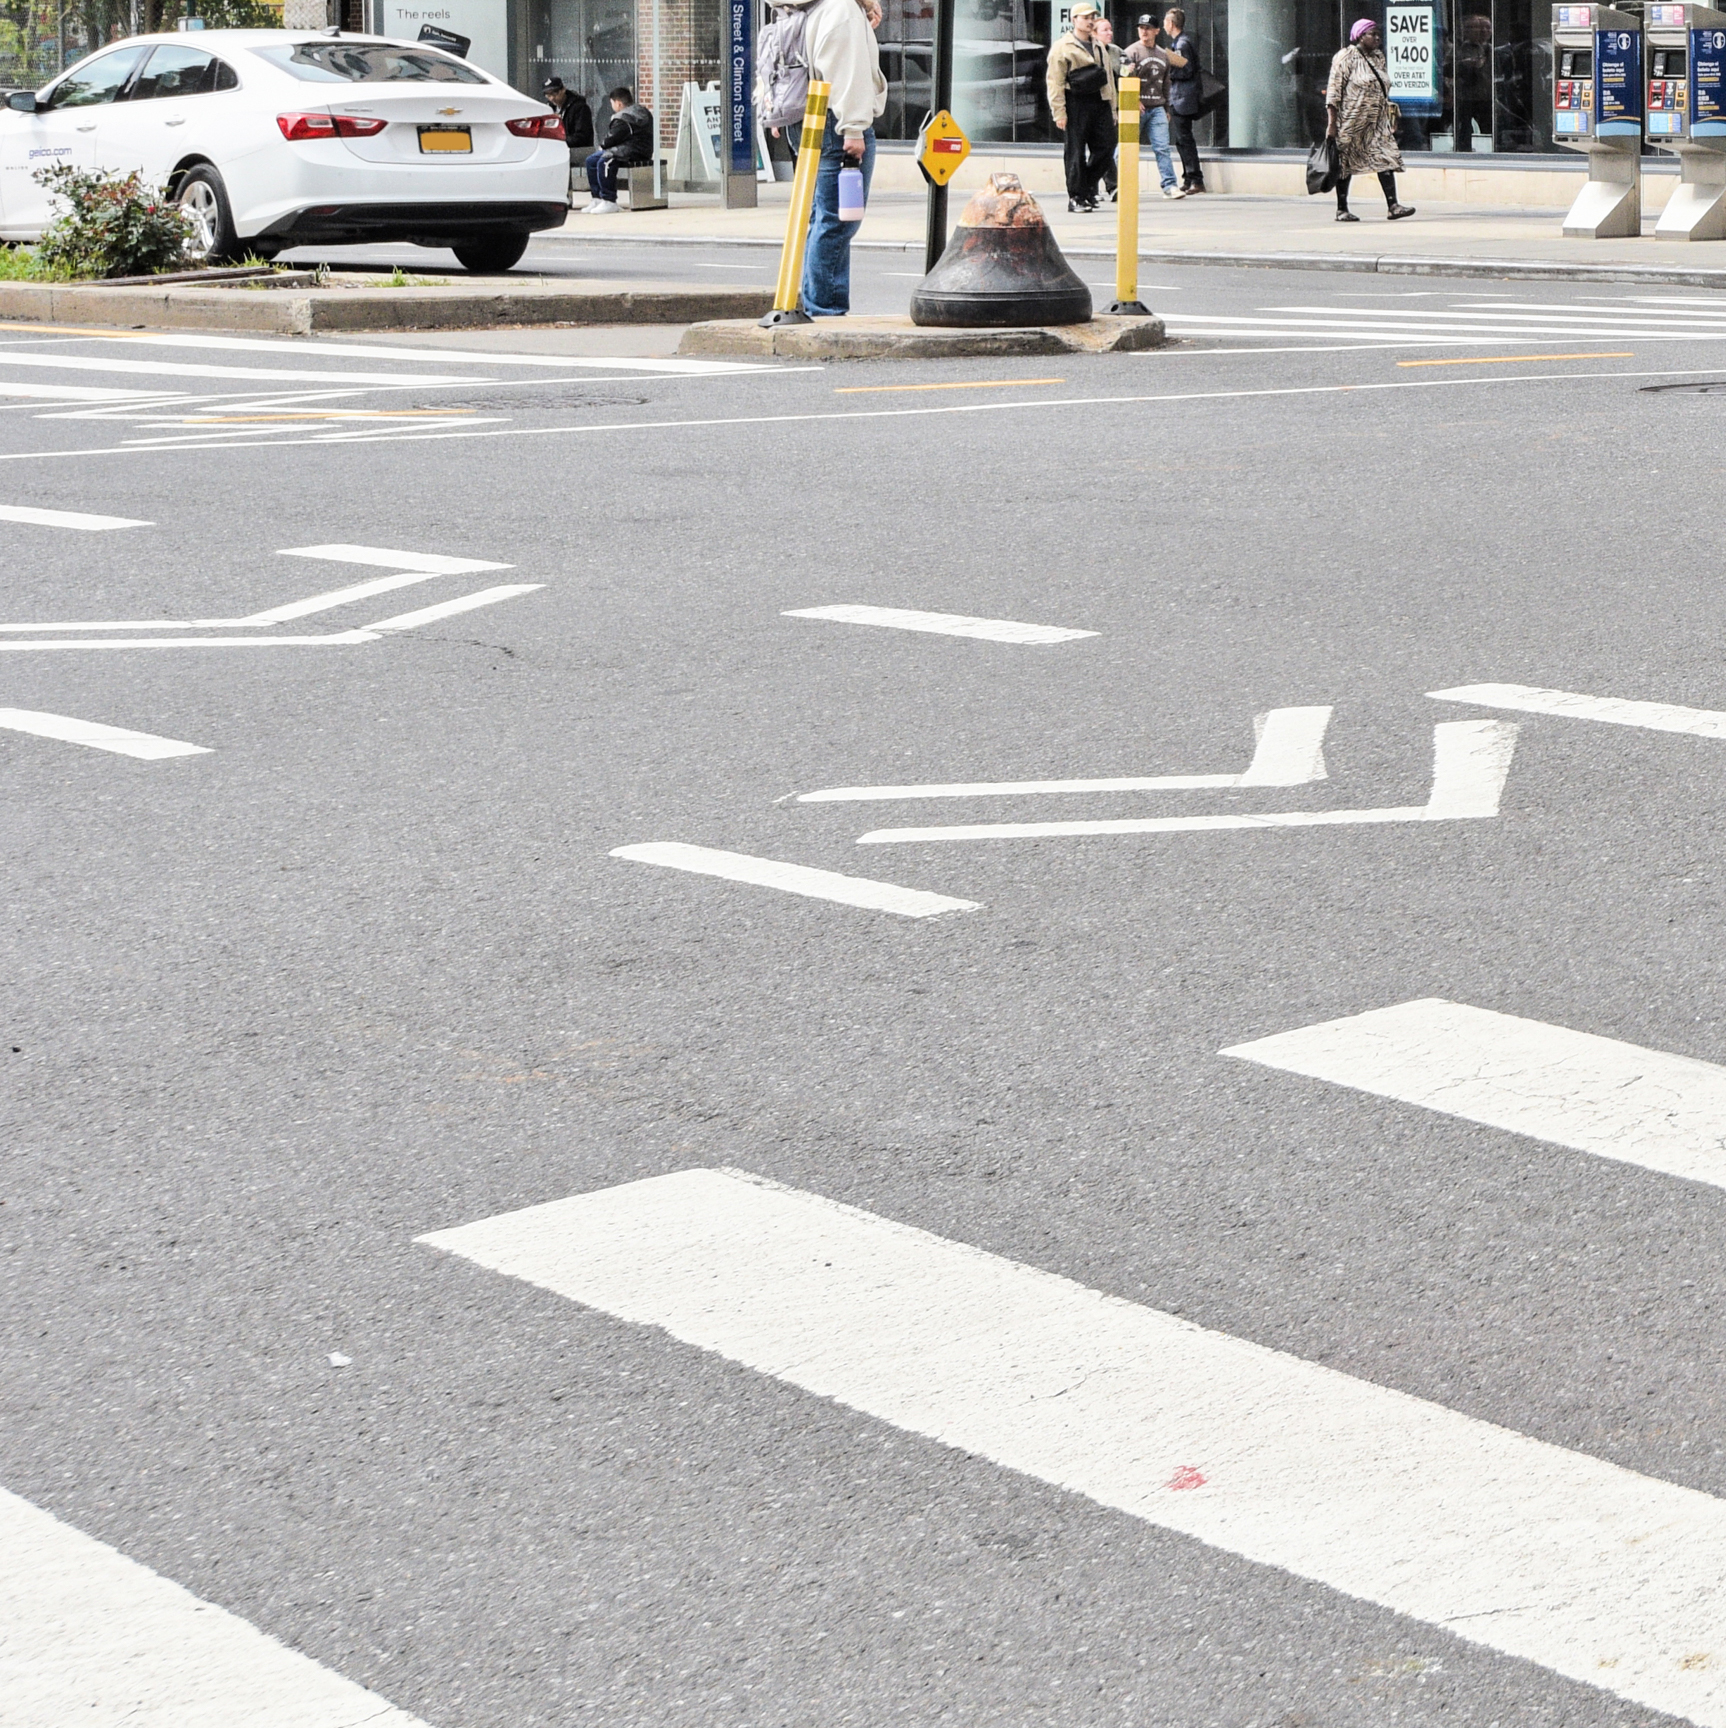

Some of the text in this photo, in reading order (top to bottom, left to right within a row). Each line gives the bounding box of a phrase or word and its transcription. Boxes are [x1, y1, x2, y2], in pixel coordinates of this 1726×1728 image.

[396, 8, 450, 19] The reels
[733, 4, 744, 41] Street
[1390, 15, 1429, 34] SAVE
[1402, 36, 1417, 44] OVER
[733, 45, 744, 53] &
[1391, 46, 1429, 65] $1,400
[733, 56, 745, 102] Clinton
[1394, 71, 1426, 80] OVER AT&T
[1403, 80, 1430, 89] VERIZON
[733, 105, 744, 142] Street
[29, 146, 72, 160] geico.com
